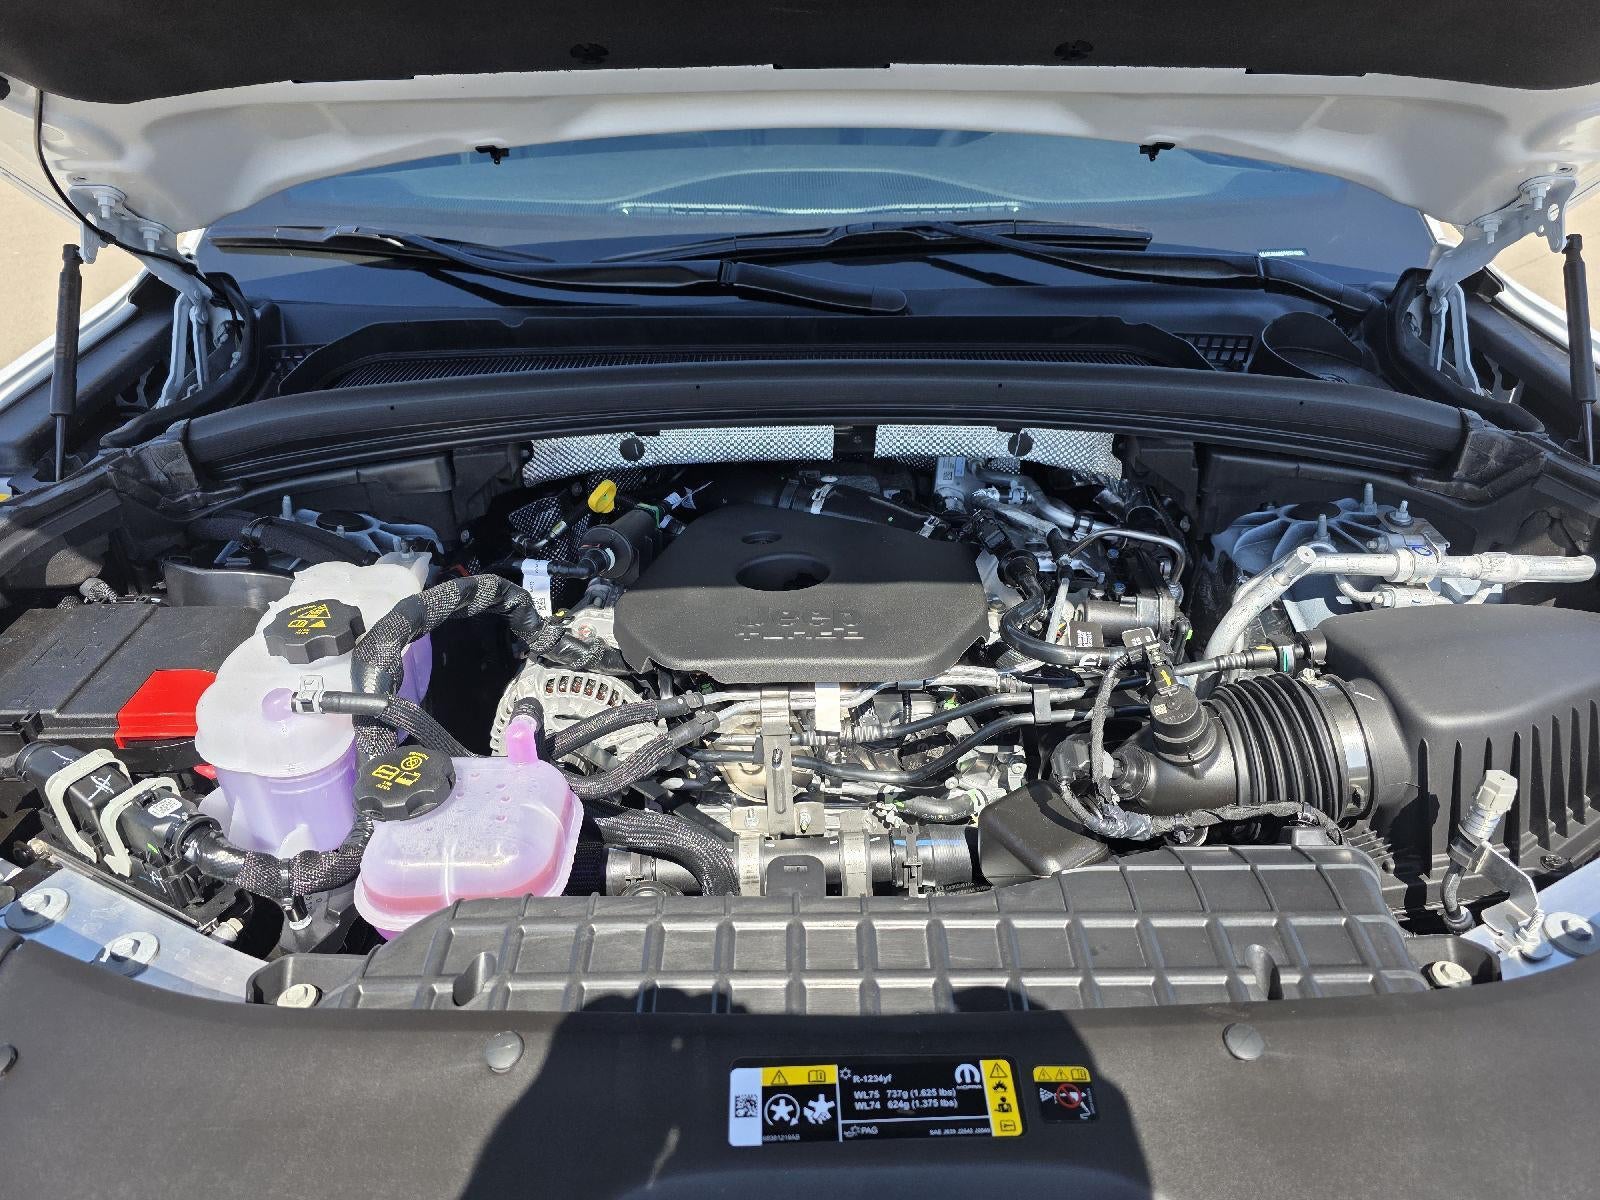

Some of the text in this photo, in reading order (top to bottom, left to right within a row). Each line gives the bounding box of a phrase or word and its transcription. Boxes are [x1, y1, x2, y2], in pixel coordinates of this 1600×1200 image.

[853, 1073, 892, 1085] R-1234yf
[853, 1087, 957, 1099] WL75 737g (1.625 lbs)
[854, 1101, 881, 1110] WL74
[940, 1098, 959, 1109] lbs)
[860, 1125, 879, 1135] PAG
